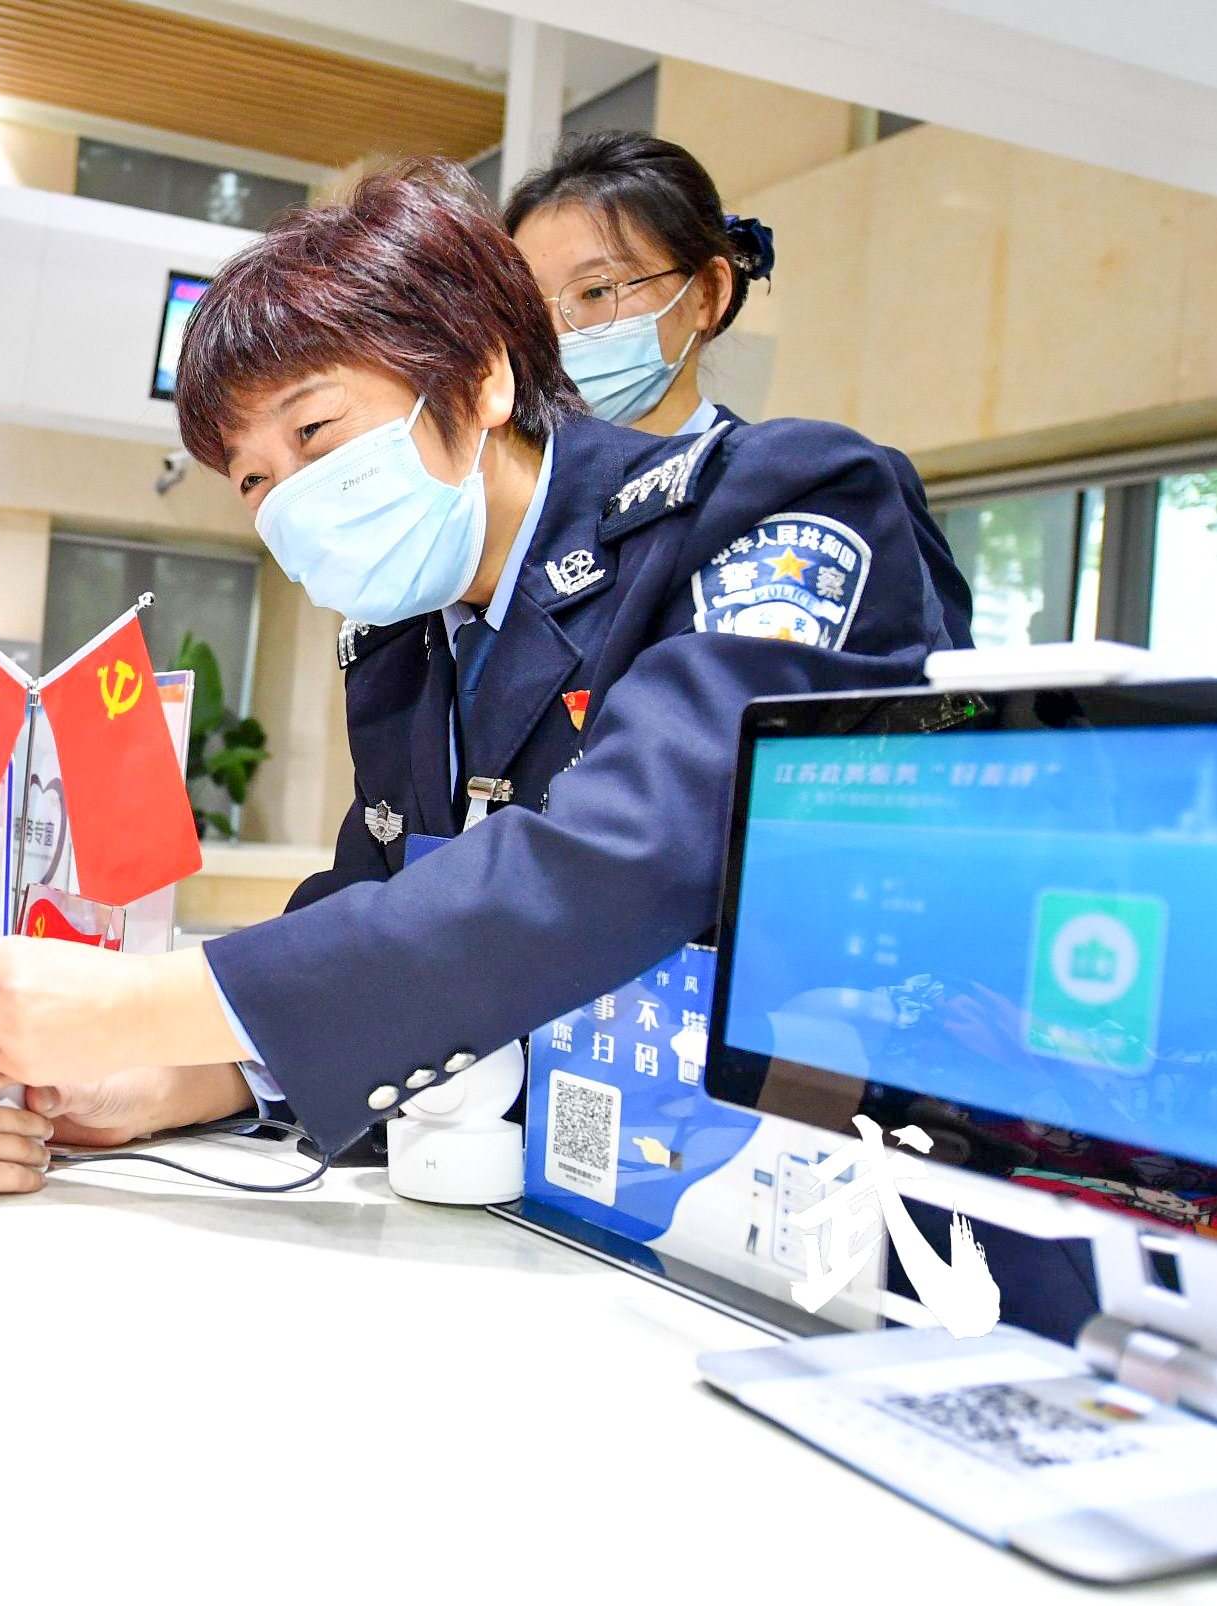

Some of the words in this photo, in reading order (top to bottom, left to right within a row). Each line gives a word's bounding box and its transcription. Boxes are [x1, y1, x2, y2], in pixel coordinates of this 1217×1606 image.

[711, 525, 857, 572] 中华人民共和国
[816, 566, 847, 601] 察
[656, 970, 699, 994] 作风
